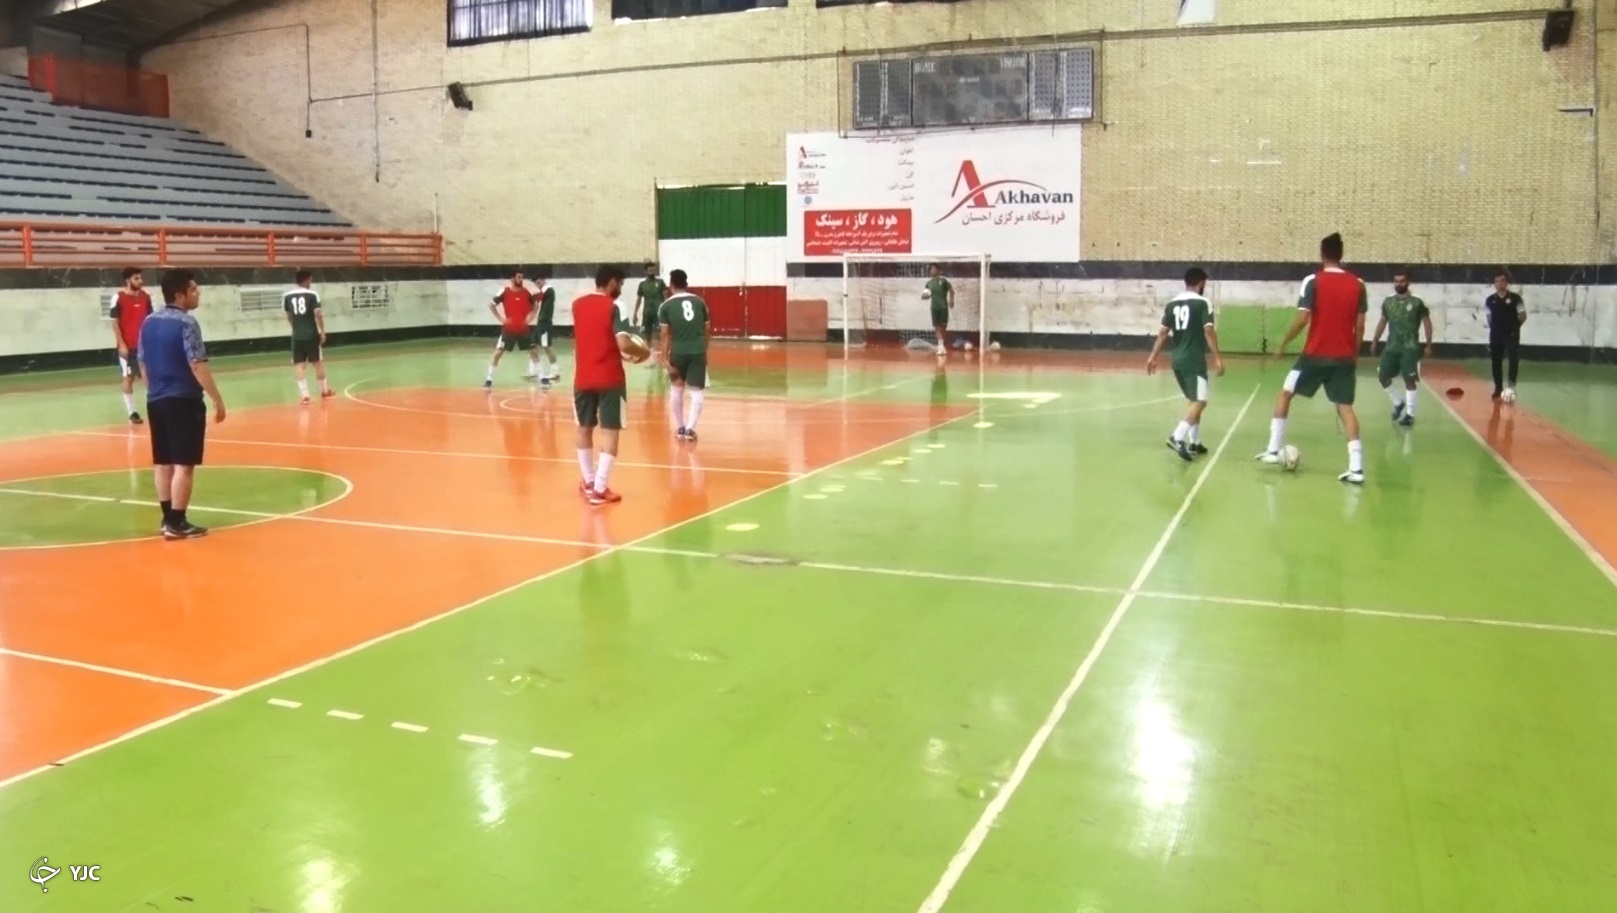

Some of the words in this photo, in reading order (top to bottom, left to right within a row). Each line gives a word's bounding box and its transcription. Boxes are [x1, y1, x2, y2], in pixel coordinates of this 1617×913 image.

[995, 189, 1074, 205] Akhavan
[815, 213, 844, 230] سینک
[962, 211, 992, 226] احسان
[994, 210, 1024, 226] مرکزی
[1027, 210, 1066, 226] فروشگاه
[291, 296, 307, 315] 18
[681, 300, 695, 322] 8
[1173, 304, 1190, 330] 19
